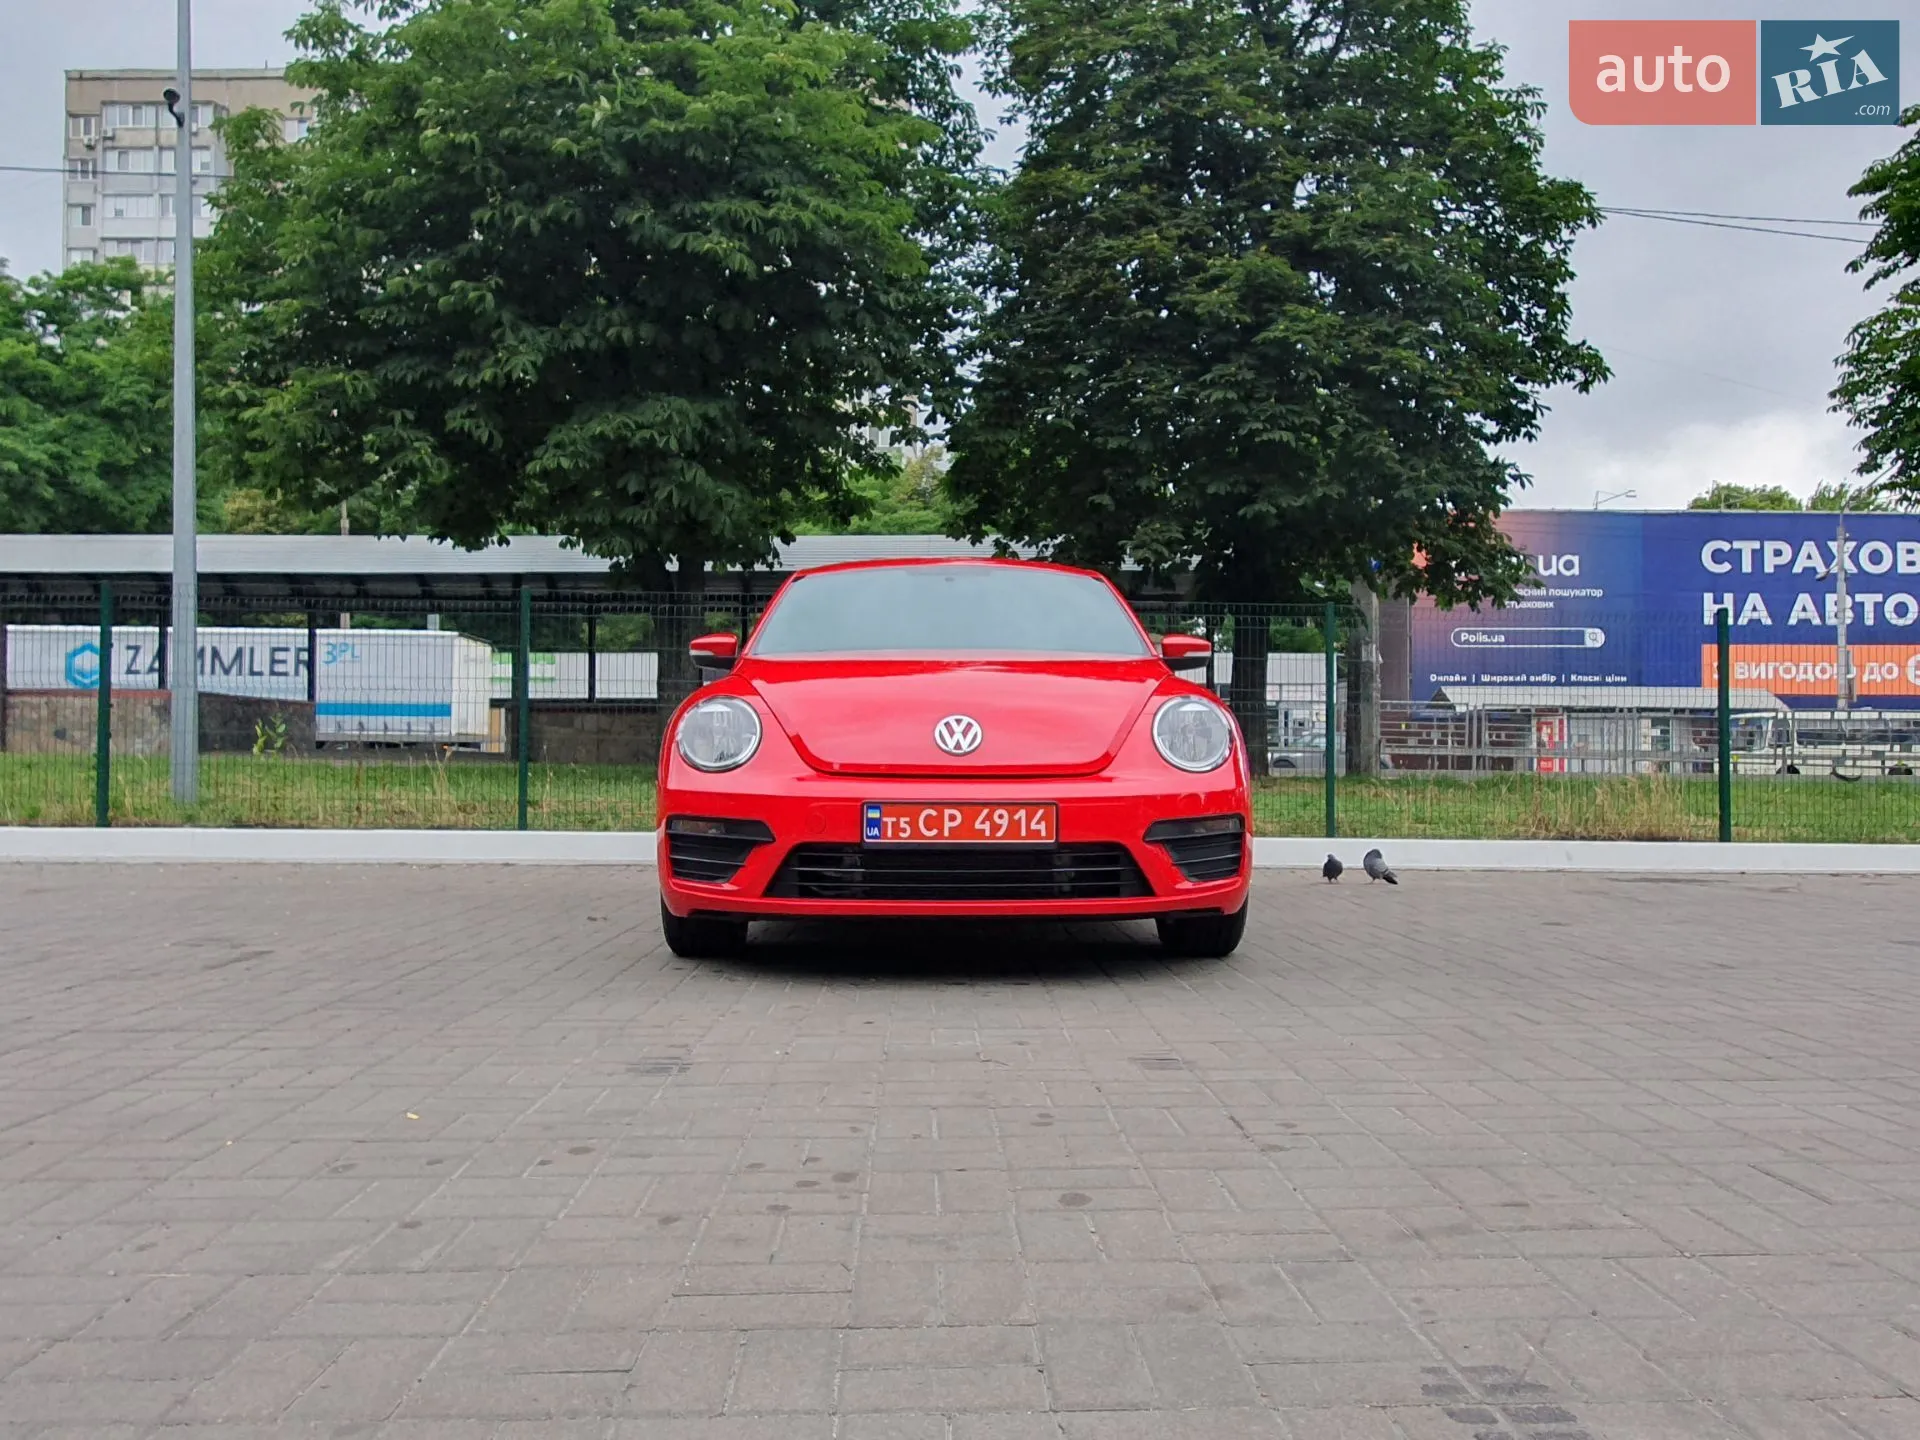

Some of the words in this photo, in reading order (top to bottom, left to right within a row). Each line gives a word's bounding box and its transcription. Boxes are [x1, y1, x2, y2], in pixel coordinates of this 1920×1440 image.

[1549, 588, 1603, 598] пошукатор
[1703, 592, 1773, 626] НА
[1787, 592, 1919, 627] АВТО
[1460, 633, 1505, 643] Polis.ua
[125, 644, 308, 677] ZMLER
[1429, 672, 1467, 682] Онлайн
[1480, 673, 1527, 682] Широкий
[1529, 673, 1557, 683] вибір
[1862, 661, 1899, 683] ДО
[883, 817, 911, 838] T5
[974, 808, 1047, 837] 4914
[867, 827, 880, 837] UA
